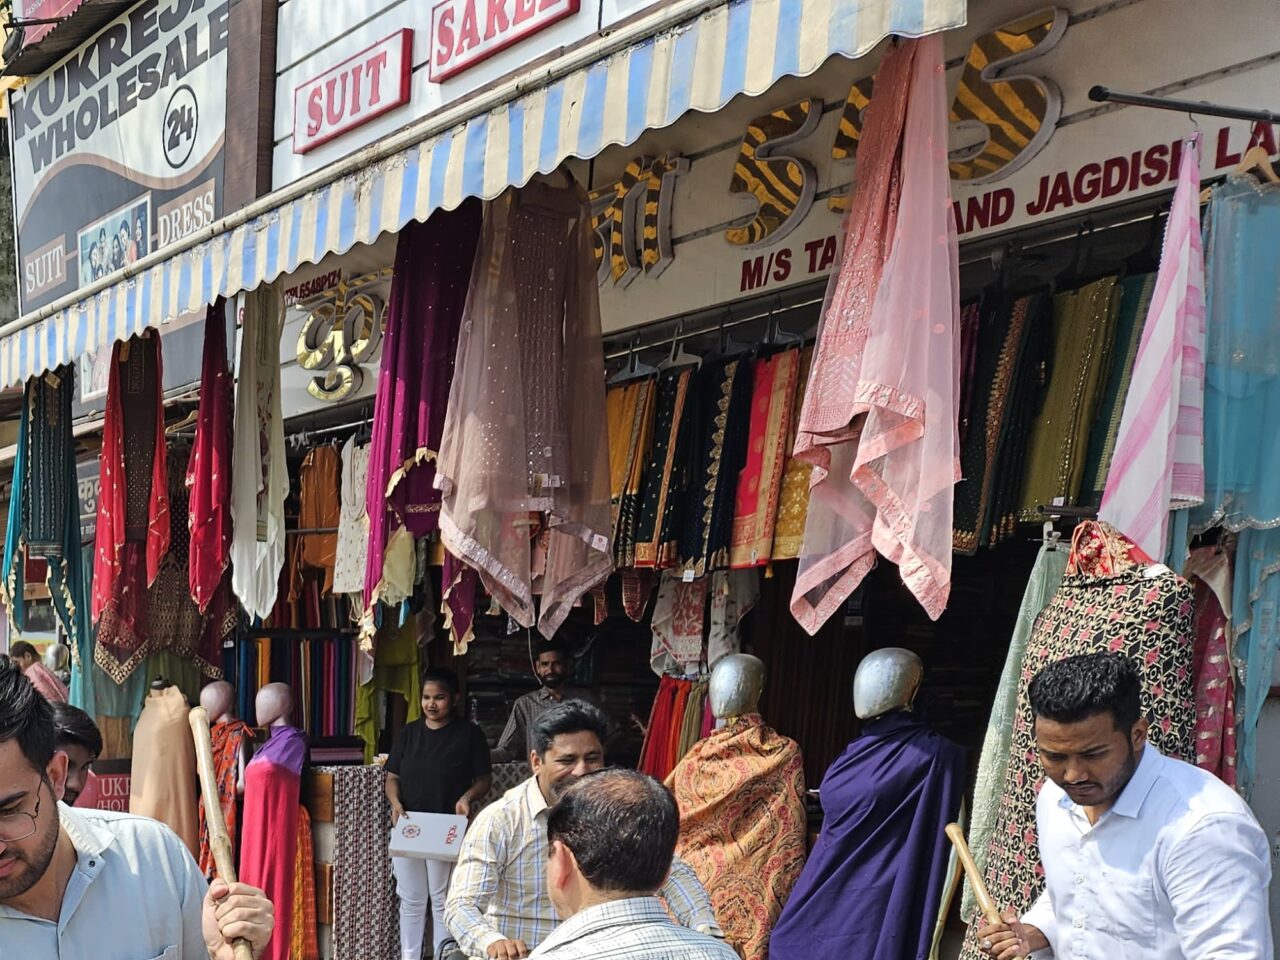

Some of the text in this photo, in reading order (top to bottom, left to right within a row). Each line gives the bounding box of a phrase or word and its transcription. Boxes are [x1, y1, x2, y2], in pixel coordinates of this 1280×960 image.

[436, 0, 560, 66] SARE
[12, 0, 206, 140] KUKREJ
[28, 4, 229, 174] WHOLESALE
[307, 51, 387, 137] SUIT
[167, 104, 193, 152] 24
[158, 190, 215, 249] DRESS
[25, 244, 65, 294] SUIT
[740, 248, 792, 292] M/S
